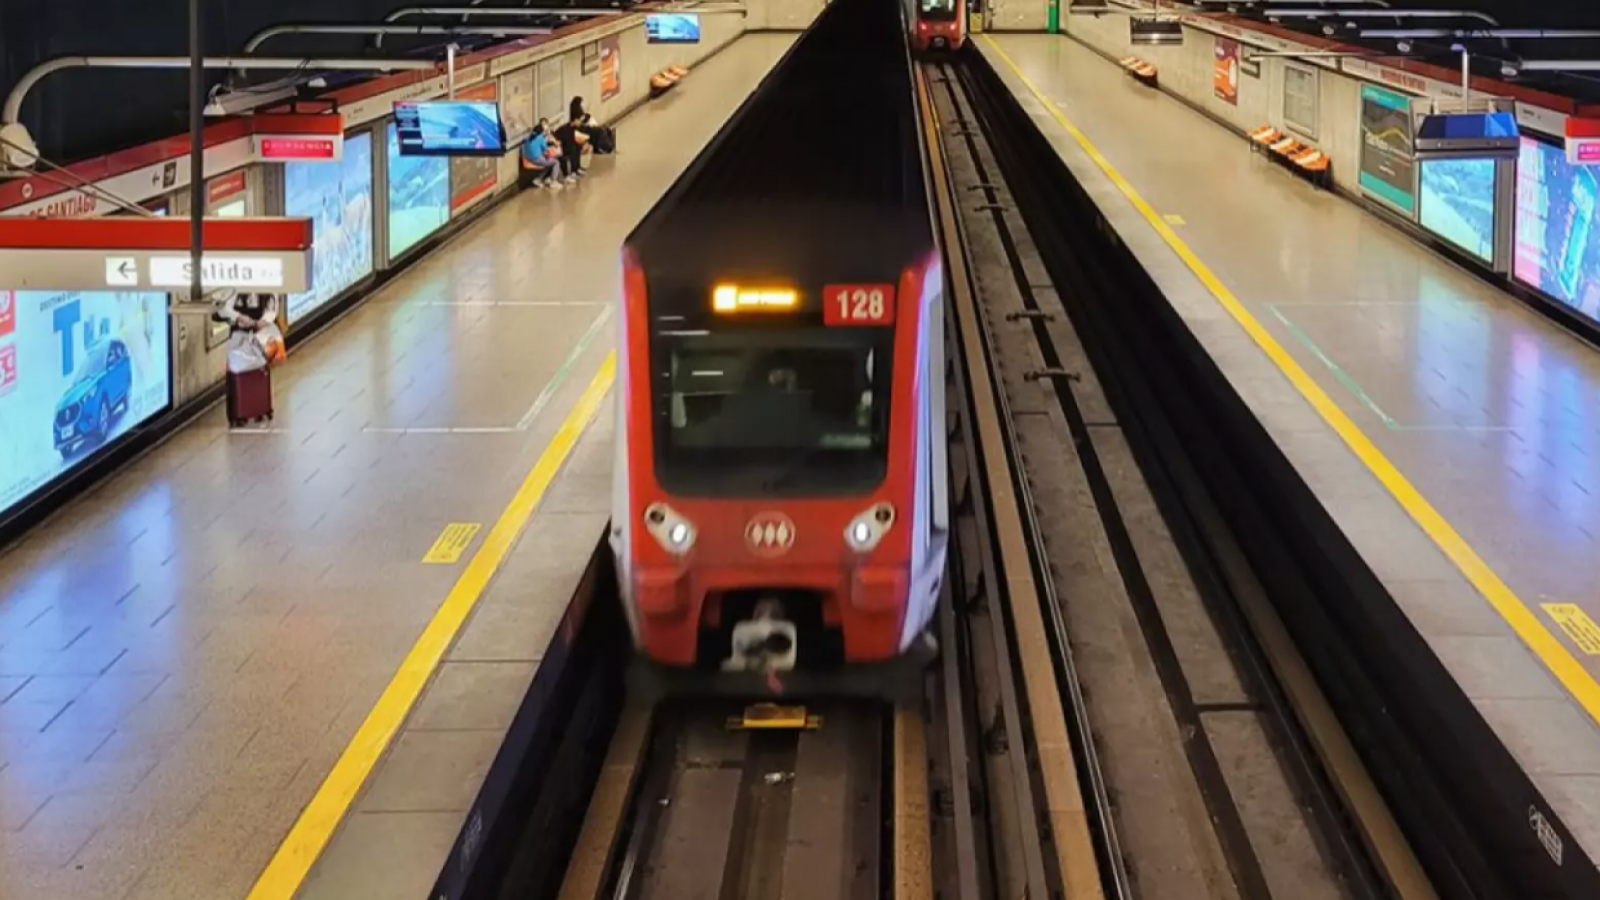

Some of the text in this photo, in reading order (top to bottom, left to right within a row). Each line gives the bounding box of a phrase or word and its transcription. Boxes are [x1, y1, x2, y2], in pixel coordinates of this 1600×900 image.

[46, 194, 96, 216] SANTIAGO
[182, 262, 253, 280] Salida
[837, 289, 884, 320] 128
